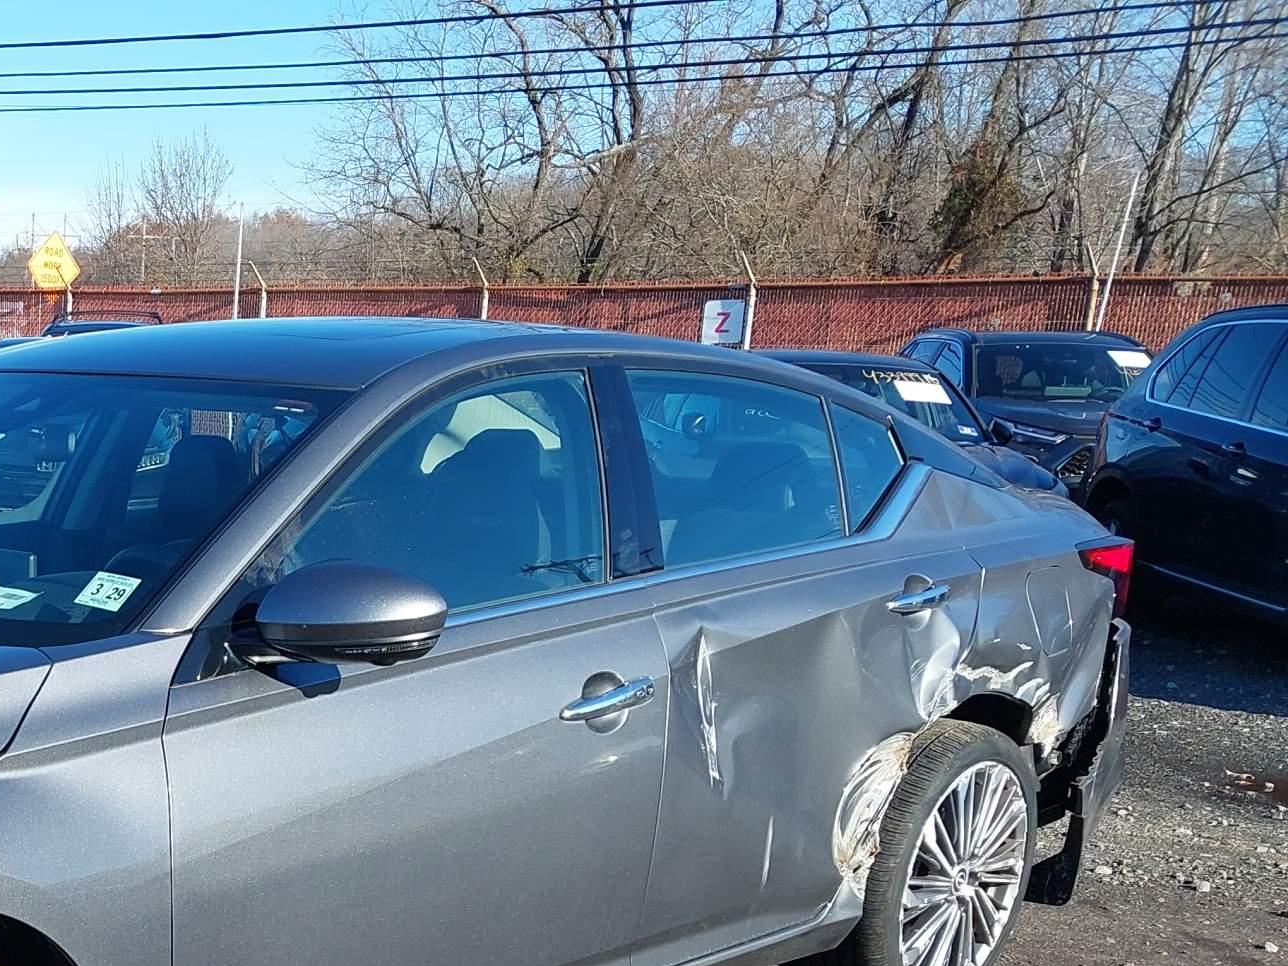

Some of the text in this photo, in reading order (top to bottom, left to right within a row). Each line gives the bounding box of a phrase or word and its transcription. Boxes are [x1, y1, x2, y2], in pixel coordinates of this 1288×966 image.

[44, 246, 64, 258] ROAD
[714, 311, 731, 333] Z
[90, 582, 104, 595] 3
[105, 586, 127, 601] 29
